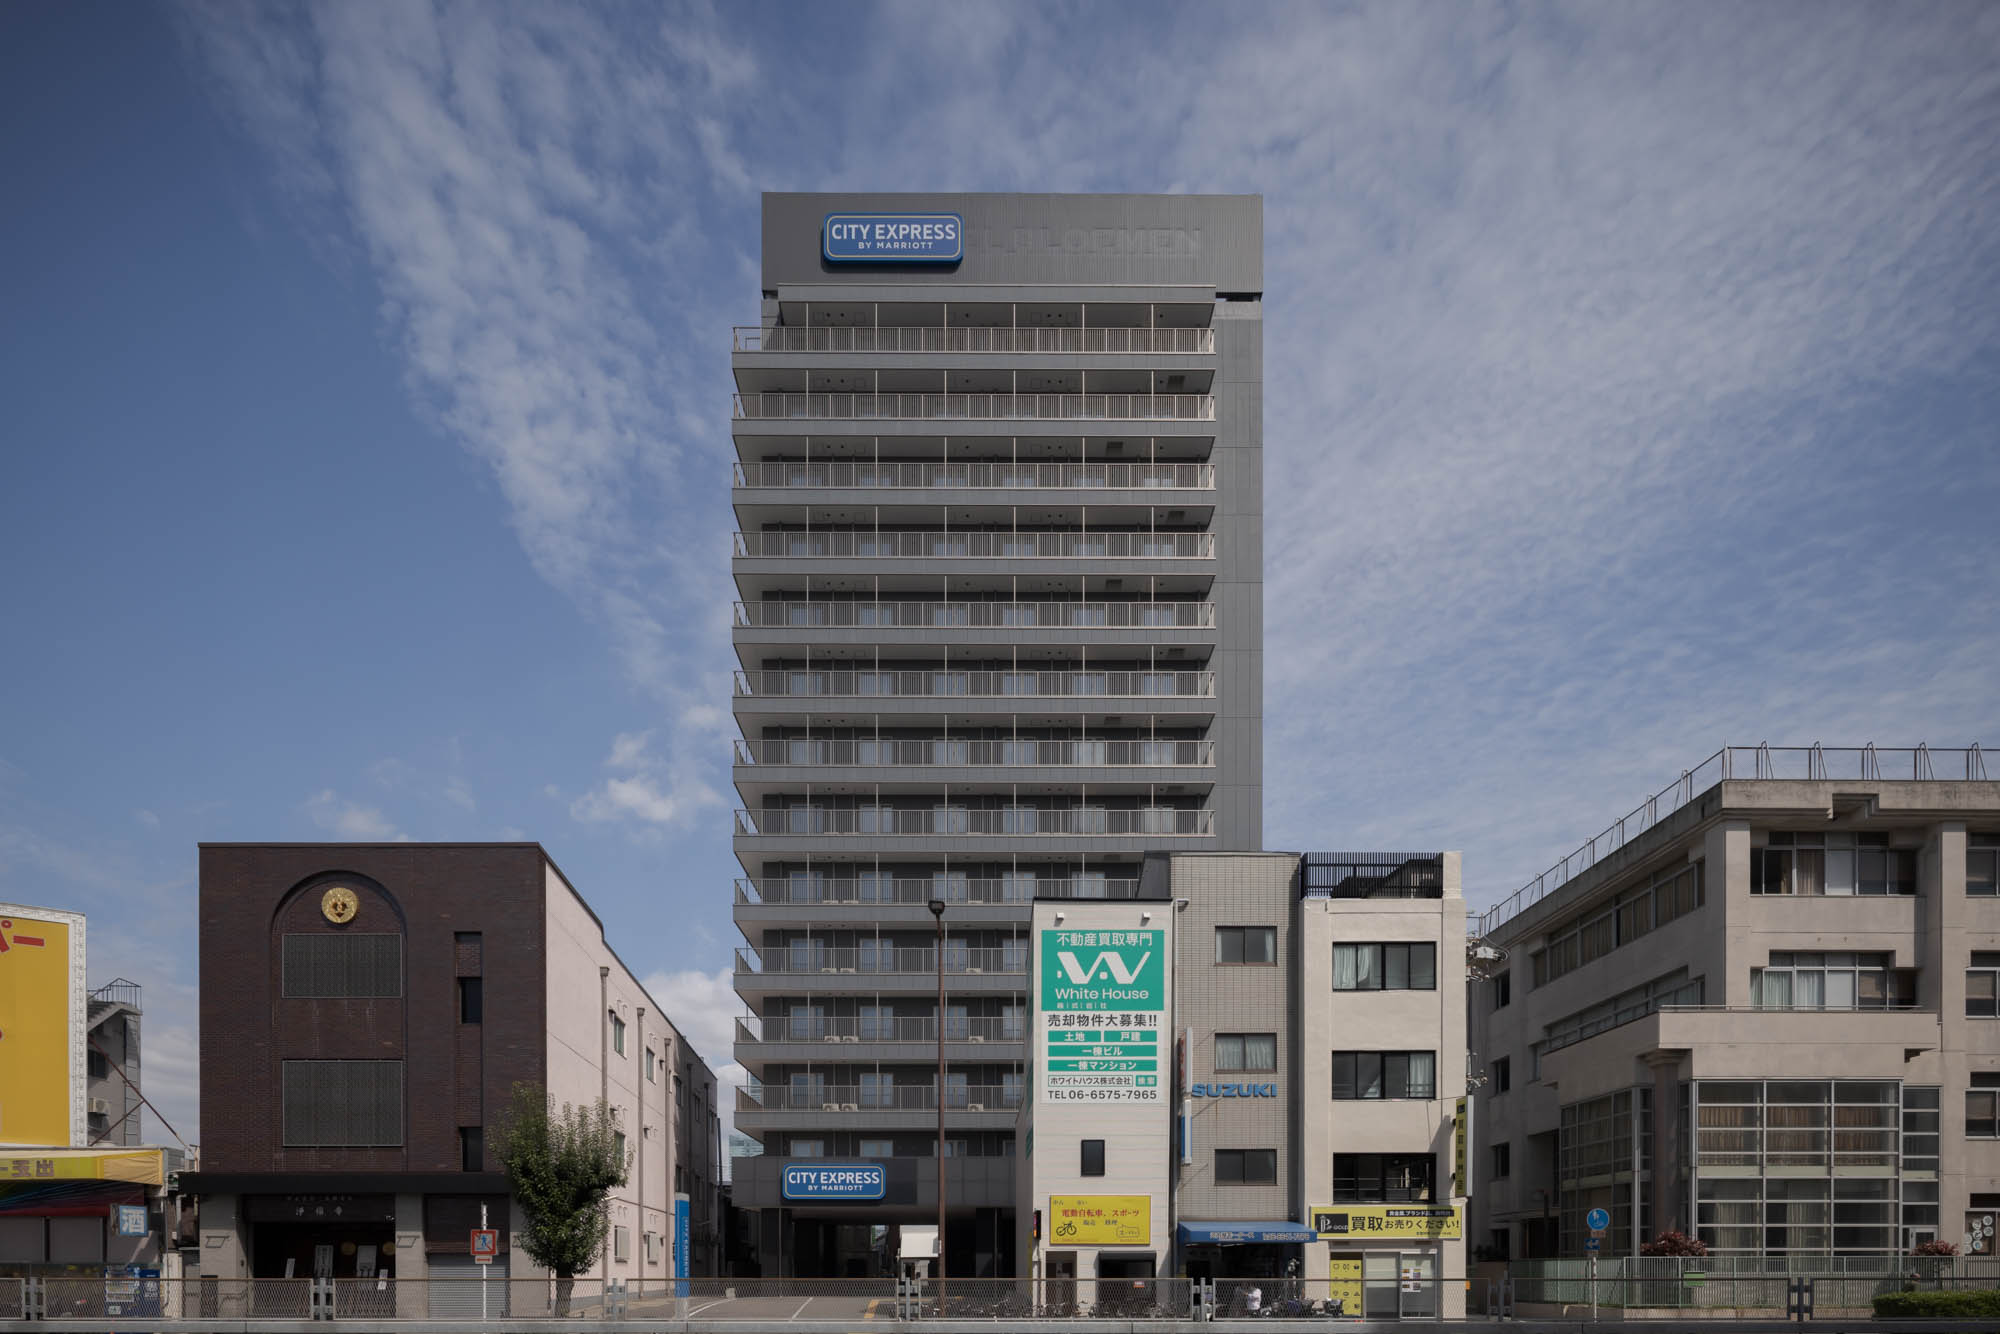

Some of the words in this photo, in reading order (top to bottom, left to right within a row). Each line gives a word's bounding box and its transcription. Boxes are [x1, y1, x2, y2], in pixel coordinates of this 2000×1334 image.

[831, 223, 871, 240] CITY
[875, 223, 956, 240] EXPRESS
[858, 241, 872, 249] BY
[876, 241, 933, 249] MARRIOTT
[1056, 932, 1152, 947] 不動産買取専門
[1055, 988, 1099, 1000] White
[1102, 988, 1149, 1000] House
[1048, 1014, 1157, 1027] 売却物件大募集!!
[1064, 1032, 1085, 1041] 土地
[1120, 1032, 1141, 1041] 戸建
[1082, 1046, 1123, 1056] 一棟ビル
[1067, 1061, 1137, 1071] 一棟マンション
[1050, 1077, 1131, 1085] ホワイトハウス株式会社
[1048, 1090, 1066, 1099] TEL
[1068, 1090, 1157, 1100] 06-6575-7965
[1191, 1082, 1278, 1098] SUZUKI
[788, 1172, 818, 1184] CITY
[820, 1172, 880, 1184] EXPRESS
[121, 1207, 145, 1233] 酒
